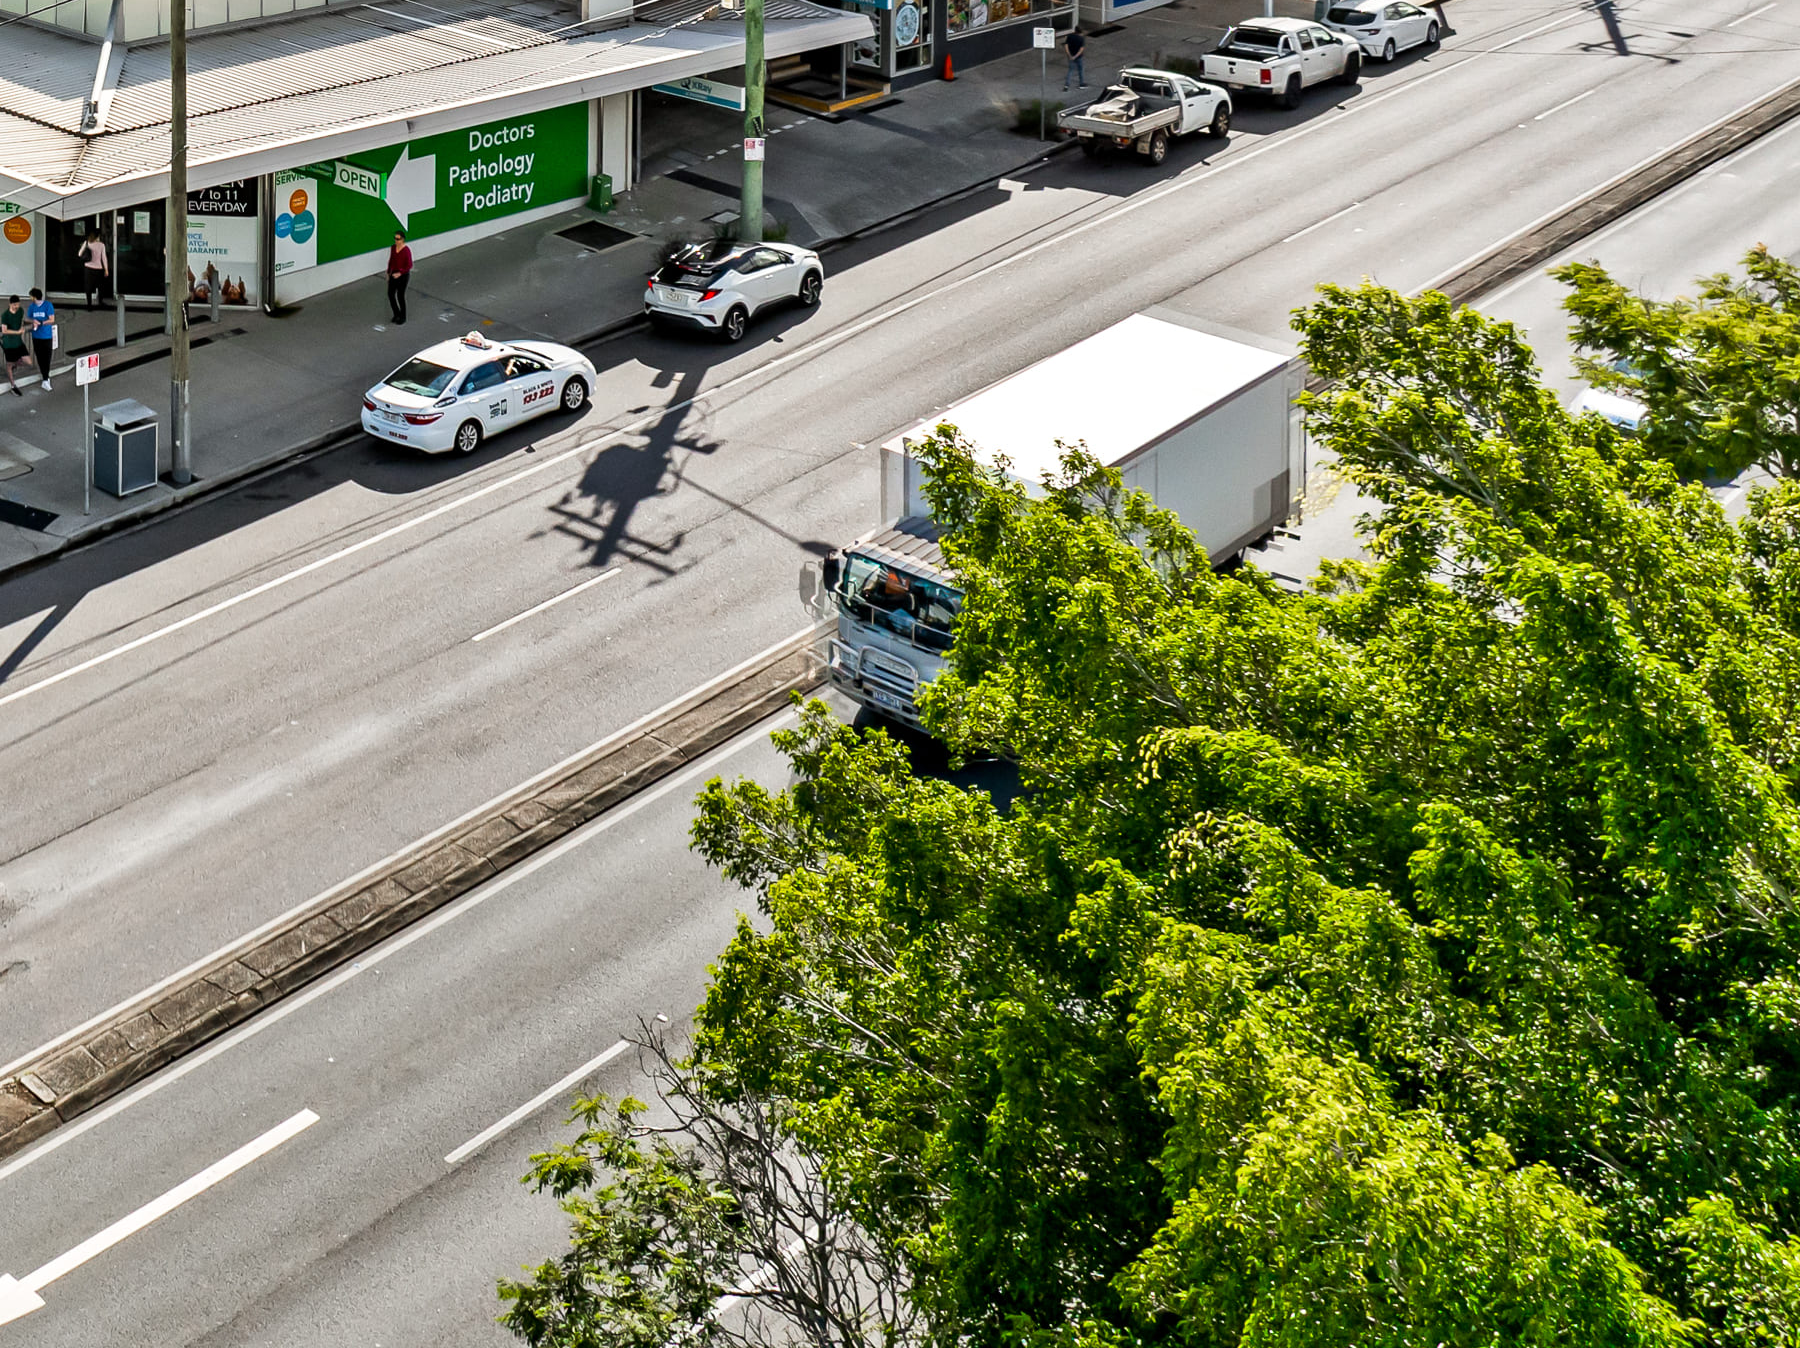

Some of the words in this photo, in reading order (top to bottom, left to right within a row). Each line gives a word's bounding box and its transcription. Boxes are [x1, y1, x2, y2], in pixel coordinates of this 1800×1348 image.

[469, 123, 535, 152] Doctors
[449, 153, 535, 187] Pathology
[339, 168, 378, 192] OPEN
[210, 190, 221, 200] to
[226, 190, 238, 200] 11
[464, 182, 535, 213] Podiatry
[188, 201, 248, 213] EVERYDAY
[187, 247, 229, 255] UARANTEE
[188, 240, 209, 248] ATCH
[539, 385, 555, 399] 222
